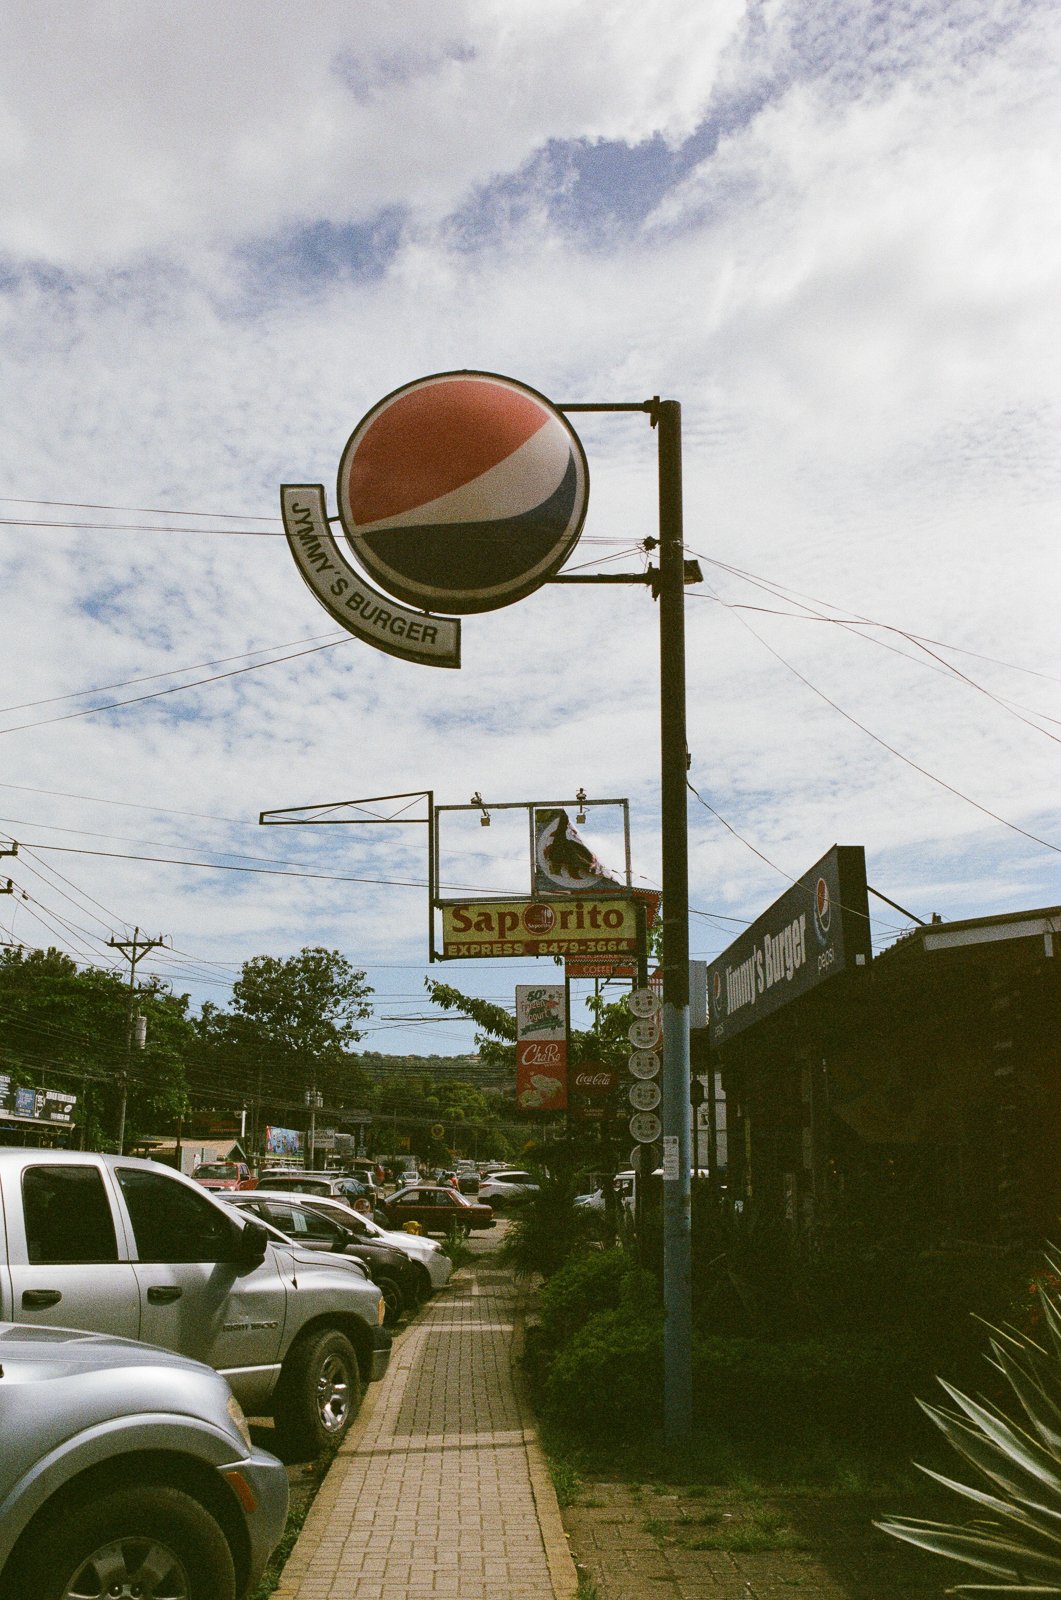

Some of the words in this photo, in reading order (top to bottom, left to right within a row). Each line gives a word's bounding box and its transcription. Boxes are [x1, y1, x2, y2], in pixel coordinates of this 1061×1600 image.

[291, 502, 349, 597] JYMMY'S
[345, 591, 439, 645] BURGER
[447, 943, 524, 956] EXPRESS
[538, 940, 629, 954] 8479-3664
[764, 912, 807, 989] Burger
